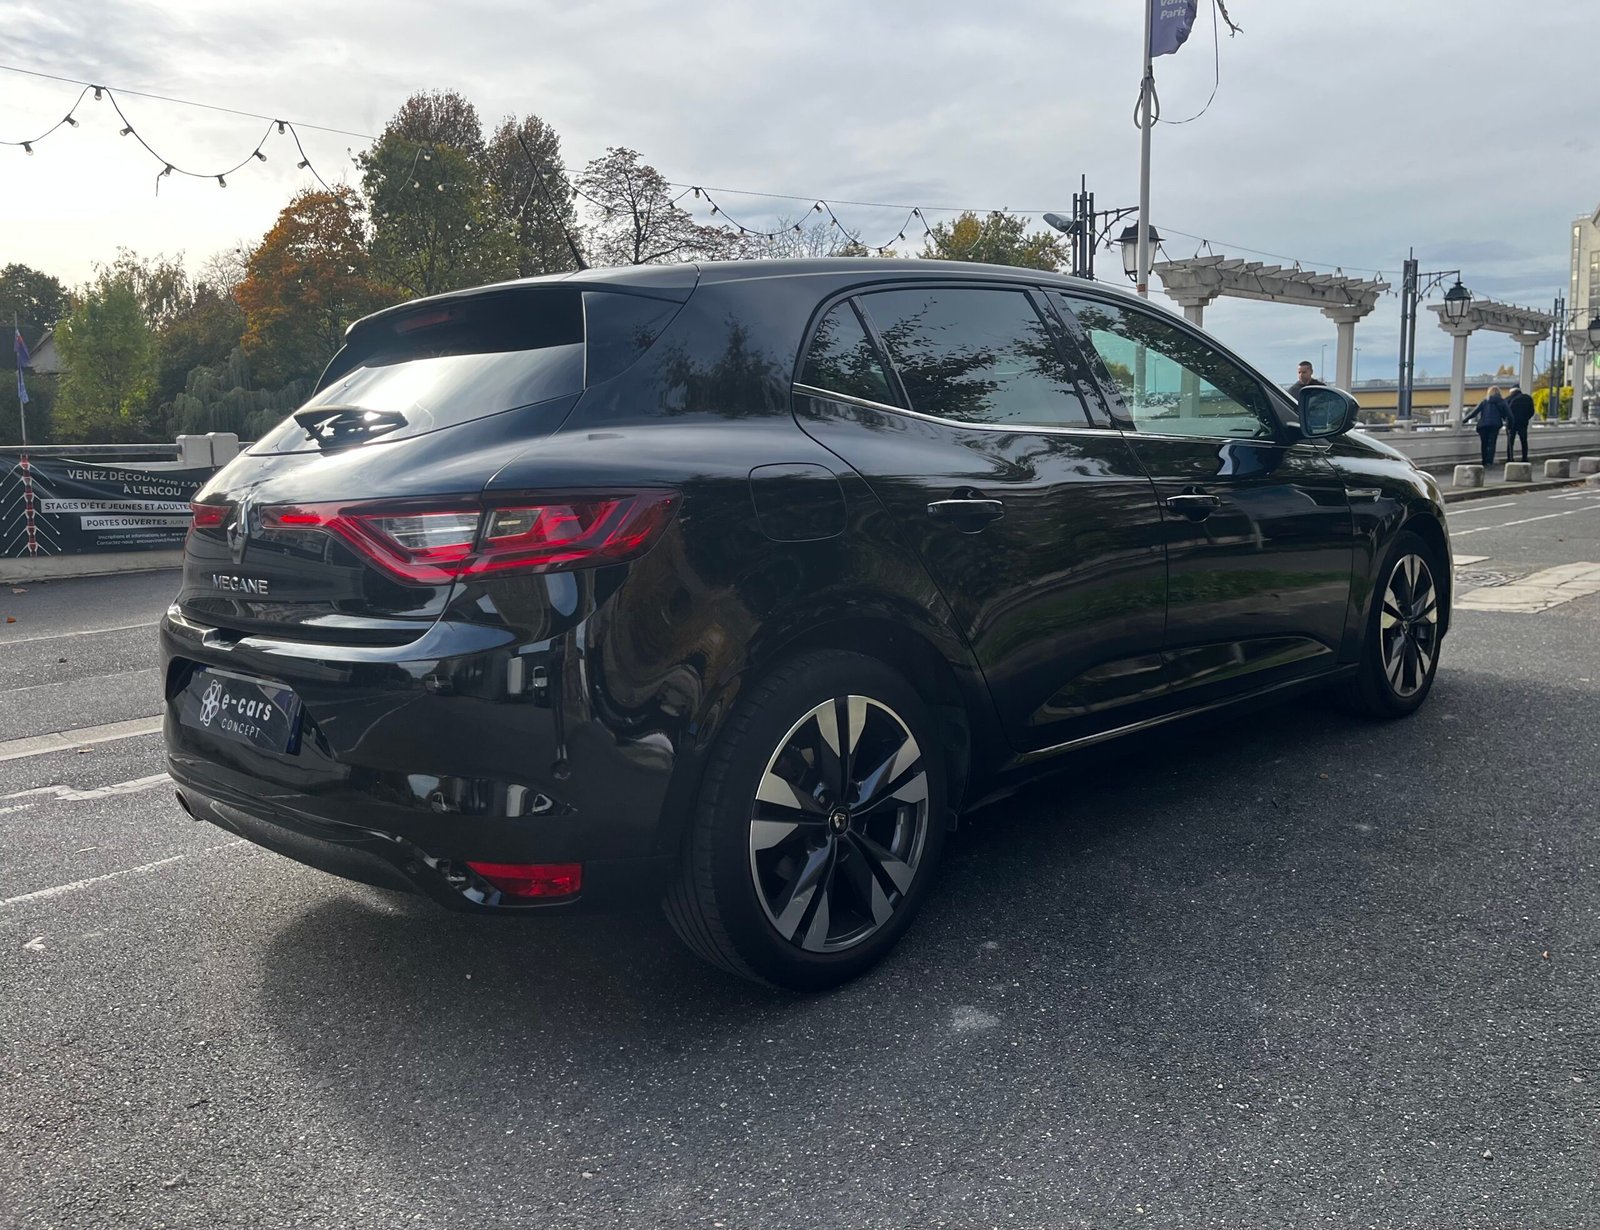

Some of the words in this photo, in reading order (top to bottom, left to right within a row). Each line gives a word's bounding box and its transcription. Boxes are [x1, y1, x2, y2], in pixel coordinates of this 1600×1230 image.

[1160, 7, 1187, 20] Paris
[67, 469, 107, 480] VENEZ
[109, 471, 178, 486] DÉCOUVRIR
[123, 484, 132, 494] À
[134, 485, 182, 496] L'ENCOU
[45, 502, 79, 510] STAGES
[81, 501, 107, 510] D'ÉTÉ
[144, 503, 155, 511] ET
[87, 519, 120, 527] PORTES
[121, 518, 168, 526] OUVERTES
[212, 574, 269, 595] MEGANE
[221, 694, 273, 721] e-cars
[221, 717, 261, 739] CONCEPT
